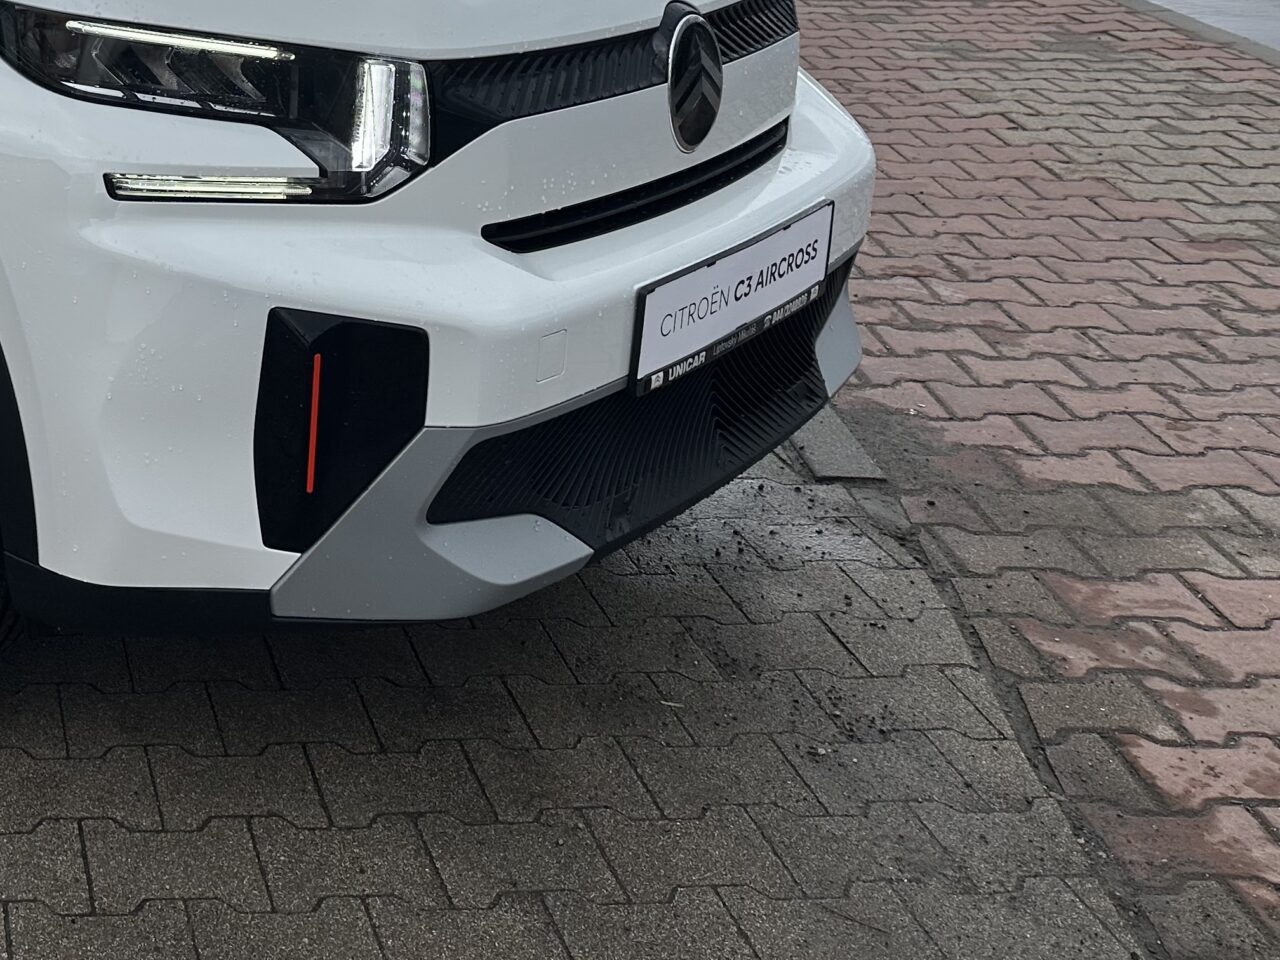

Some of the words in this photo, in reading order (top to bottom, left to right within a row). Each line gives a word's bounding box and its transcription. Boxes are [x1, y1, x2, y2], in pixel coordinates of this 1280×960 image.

[660, 285, 731, 338] CITROËN
[734, 275, 754, 303] C3
[754, 239, 819, 293] AIRCROSS
[669, 351, 707, 381] UNICAR
